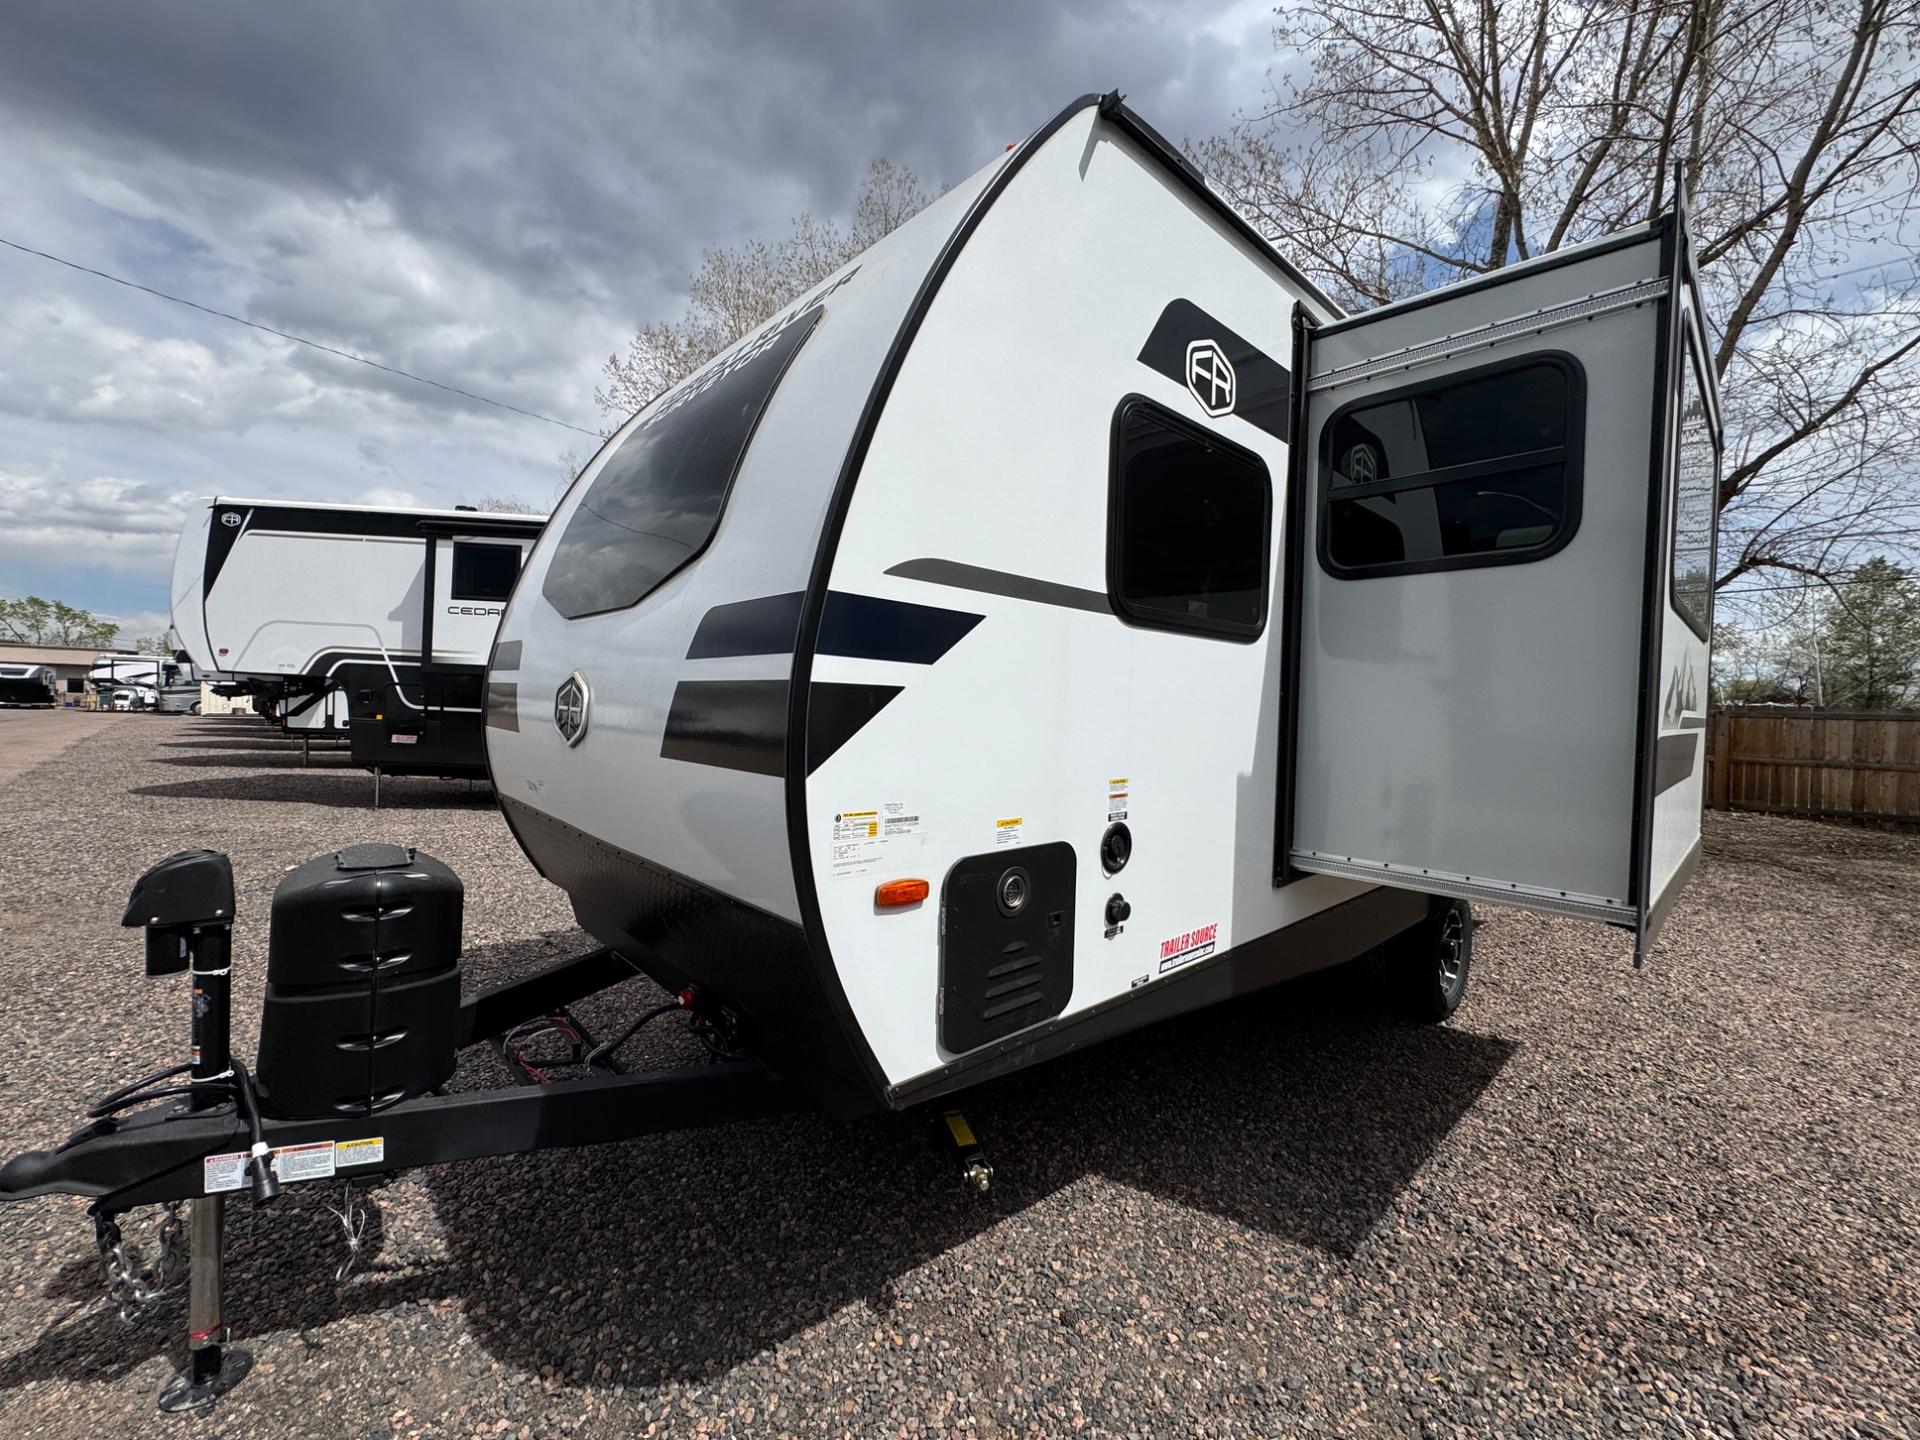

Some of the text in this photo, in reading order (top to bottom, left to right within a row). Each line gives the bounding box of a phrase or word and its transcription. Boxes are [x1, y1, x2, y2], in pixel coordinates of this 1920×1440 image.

[654, 263, 864, 414] FOREST RIVER
[643, 332, 782, 431] SURVEYOR
[447, 606, 505, 617] CEDA
[1159, 923, 1218, 960] TRAILER SOURCE
